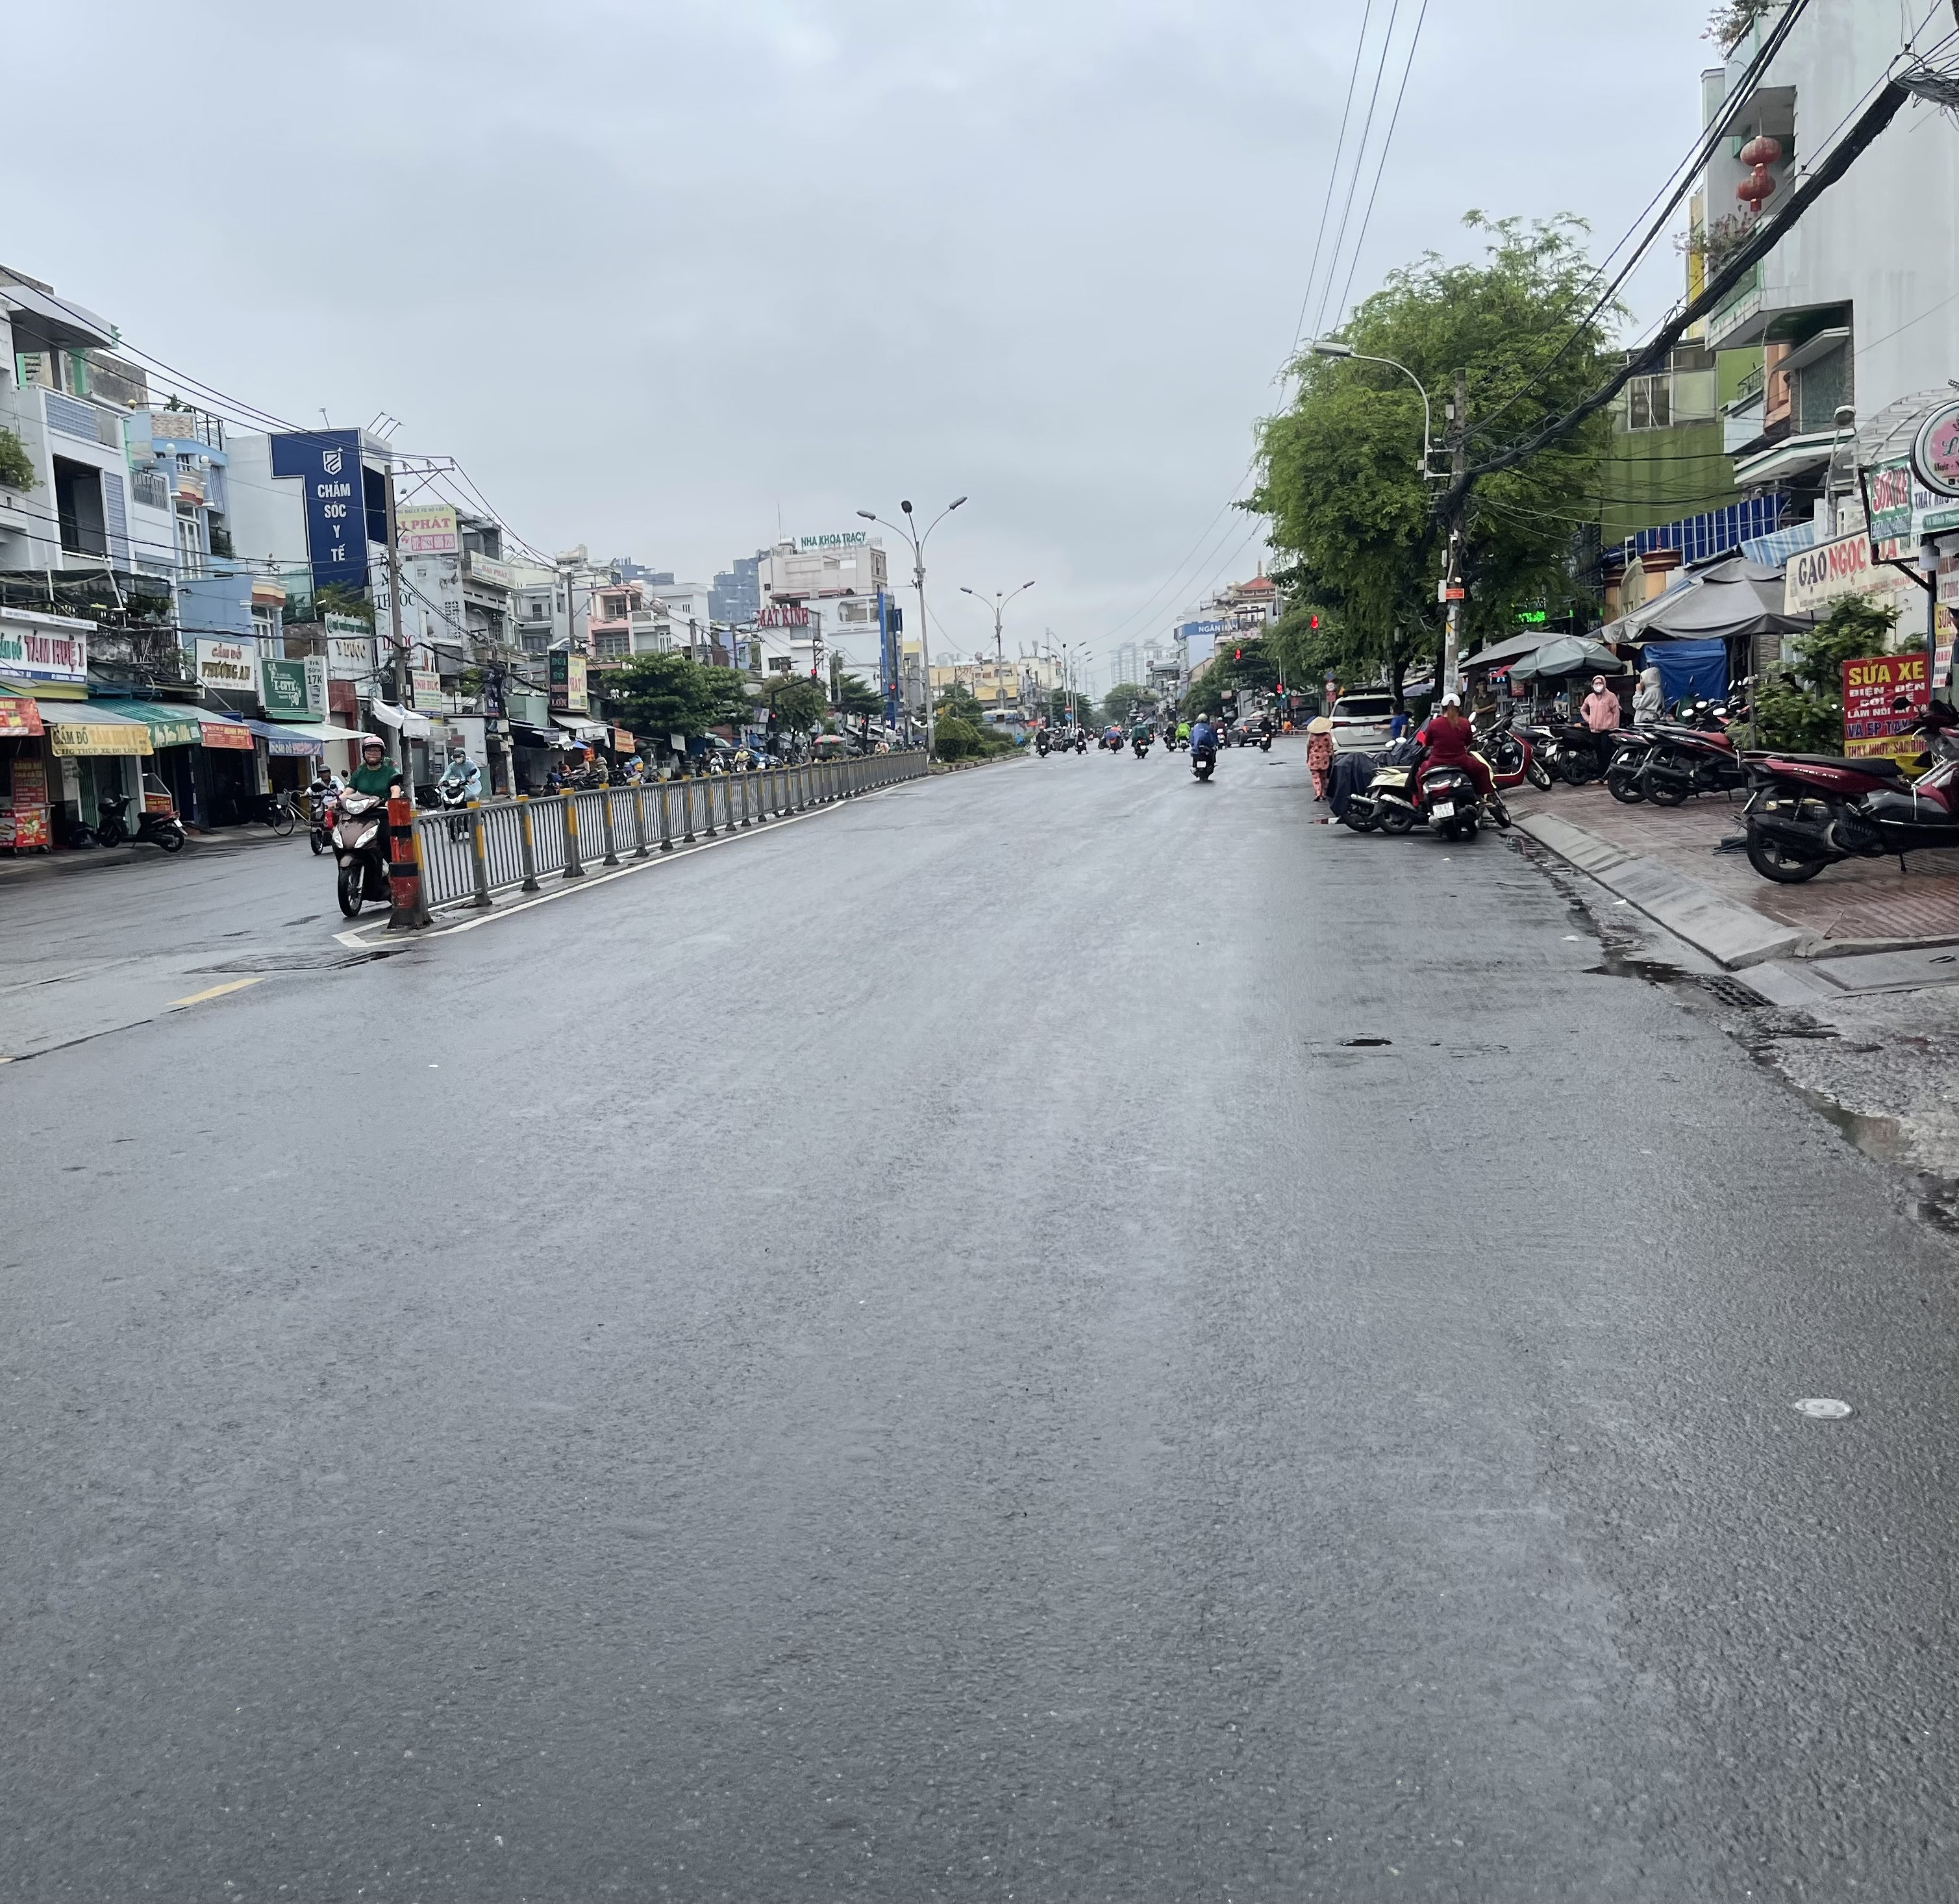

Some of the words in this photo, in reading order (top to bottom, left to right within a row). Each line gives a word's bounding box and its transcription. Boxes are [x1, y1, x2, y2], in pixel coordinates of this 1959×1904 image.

[318, 481, 351, 498] CHĂM
[324, 501, 347, 518] SÓC
[332, 525, 340, 538] Y
[801, 536, 817, 547] NHA
[819, 534, 841, 545] KHOA
[842, 532, 866, 544] TRACY
[331, 544, 345, 562] TẾ
[1799, 551, 1827, 594] GẠO
[1828, 536, 1866, 585] NGỌC
[1198, 624, 1220, 633] NGÂN
[307, 675, 322, 684] 17K
[1849, 660, 1891, 686] SỬA
[1898, 661, 1924, 681] XE
